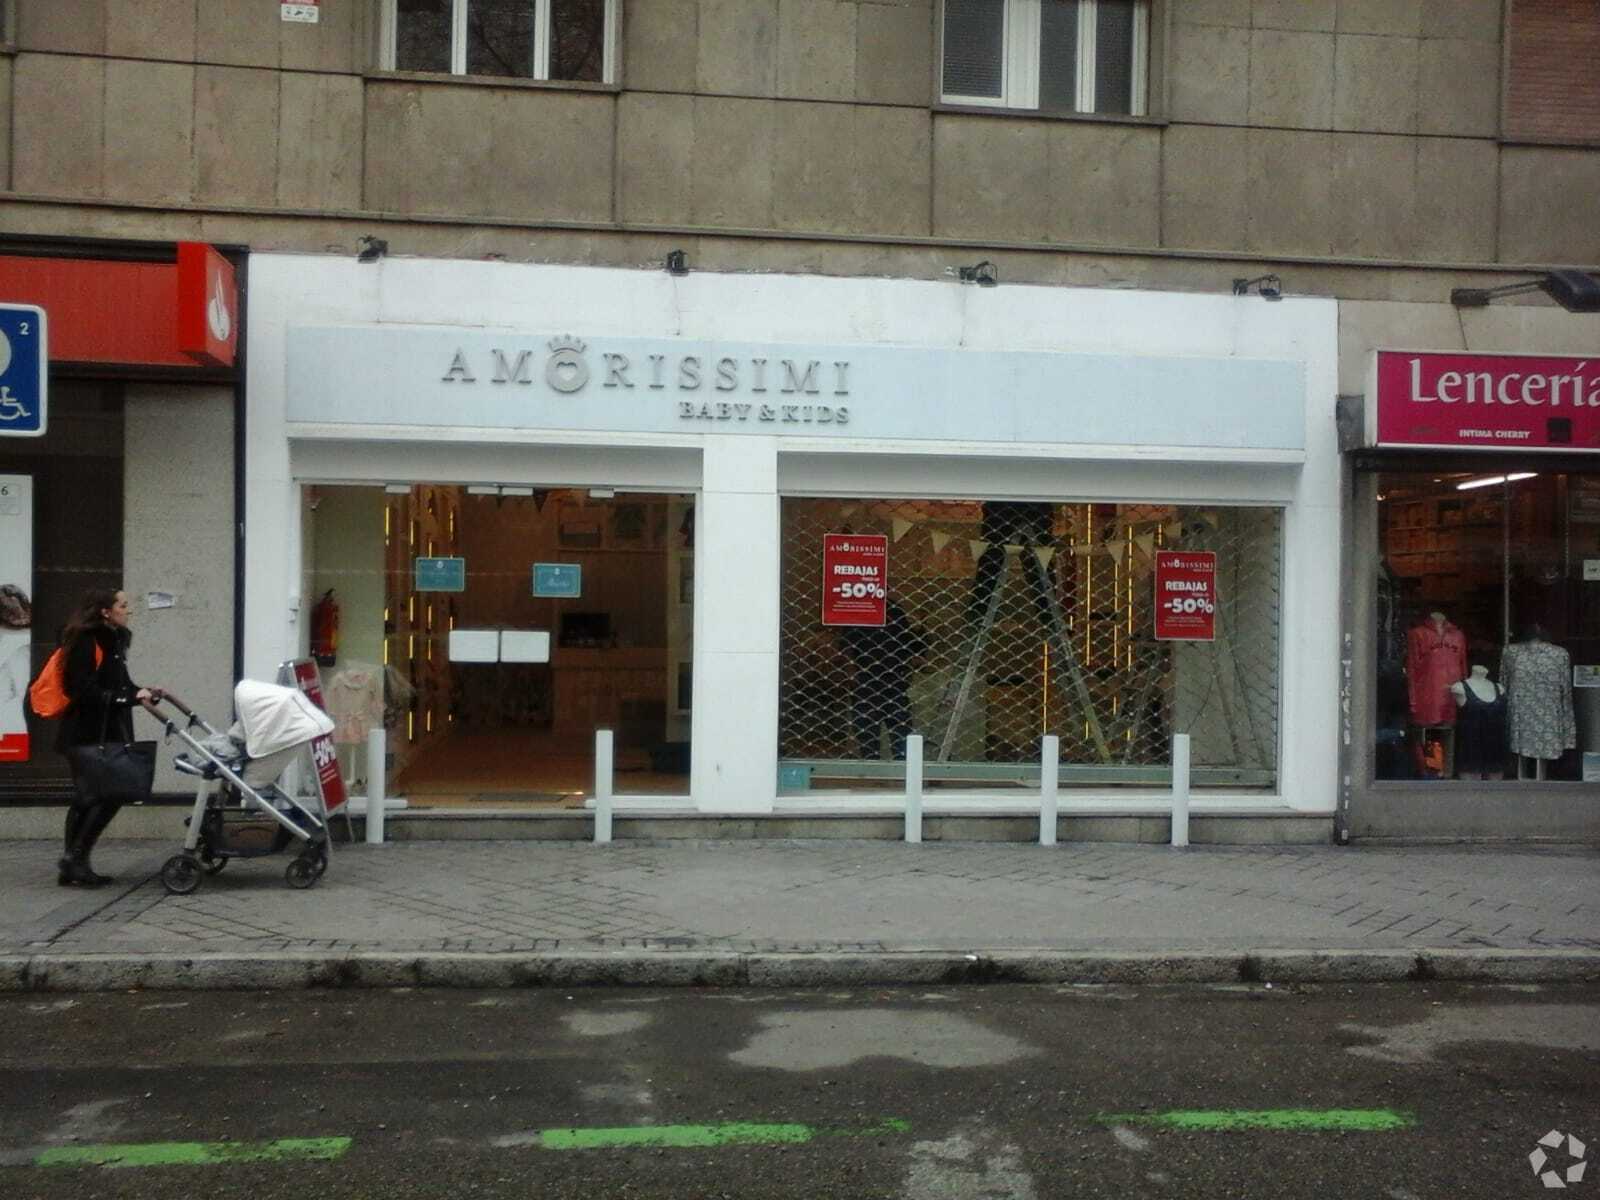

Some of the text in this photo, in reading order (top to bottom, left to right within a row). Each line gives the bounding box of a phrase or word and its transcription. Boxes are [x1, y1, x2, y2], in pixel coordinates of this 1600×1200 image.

[19, 322, 30, 336] 2
[441, 342, 849, 395] AMORISSIMI
[679, 402, 849, 424] BABY & KIDS
[834, 565, 878, 576] REBAJAS
[832, 582, 885, 599] -50%
[1165, 581, 1208, 592] REBAJAS
[1164, 598, 1214, 614] -50%
